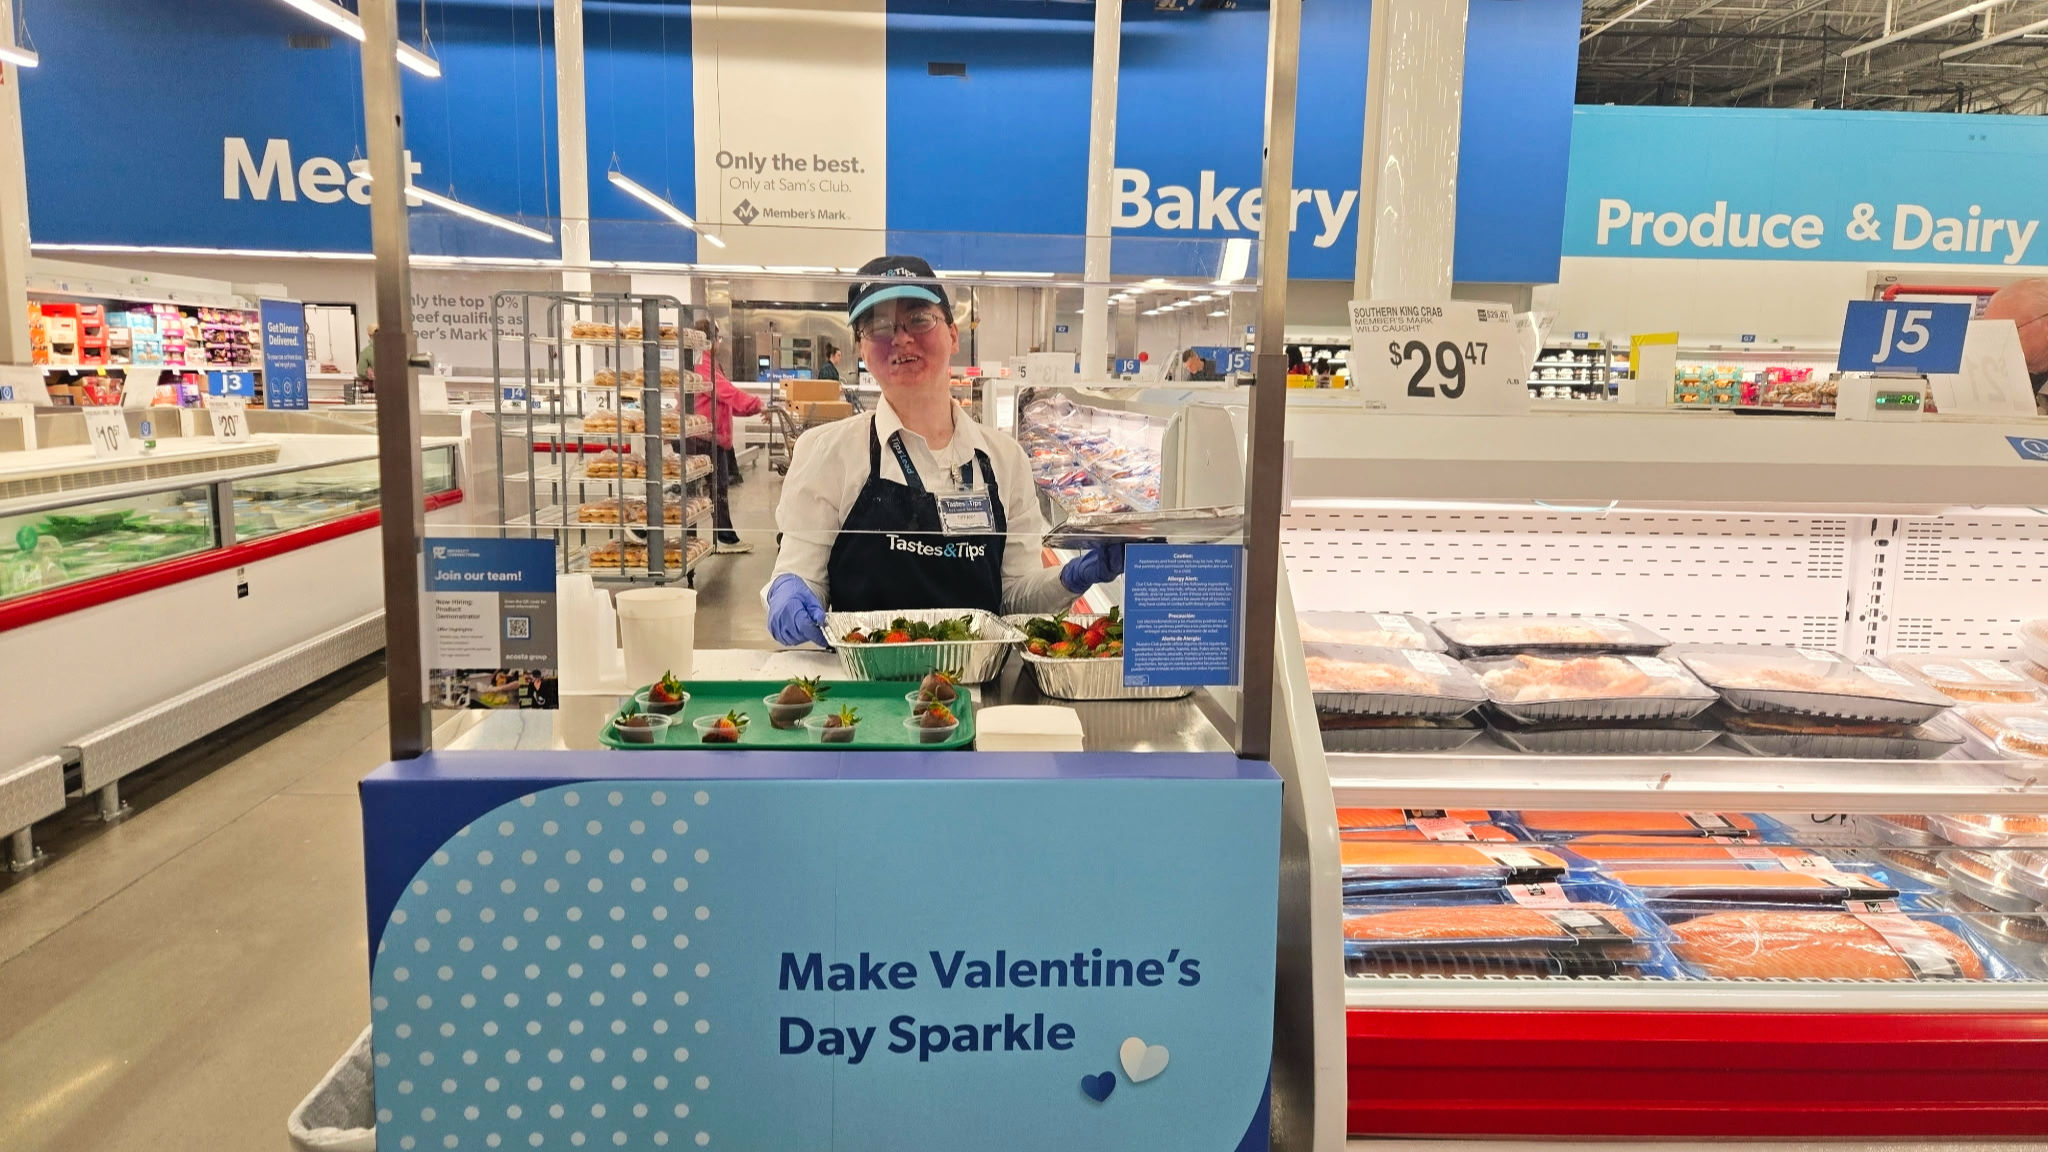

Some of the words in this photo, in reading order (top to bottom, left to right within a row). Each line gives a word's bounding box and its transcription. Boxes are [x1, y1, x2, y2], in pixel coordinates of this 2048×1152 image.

[715, 150, 767, 175] Only
[771, 153, 807, 172] the
[813, 154, 865, 174] best.
[223, 136, 423, 207] Meat
[729, 176, 760, 193] Only
[763, 179, 776, 191] at
[779, 178, 816, 192] Sam's
[819, 179, 852, 193] Club.
[762, 207, 815, 219] Member's
[817, 209, 846, 220] Mark
[1110, 167, 1359, 249] Bakery
[1596, 198, 1825, 249] Produce
[1845, 202, 1882, 242] &
[1892, 203, 2040, 265] Dairy
[432, 294, 457, 307] the
[460, 295, 485, 310] top
[1353, 306, 1398, 318] SOUTHERN
[1399, 305, 1420, 317] KING
[1420, 306, 1443, 318] CRAB
[267, 321, 280, 333] Get
[279, 323, 299, 334] Dinner
[507, 316, 524, 325] as
[1354, 317, 1405, 325] MEMBER'S
[1406, 316, 1433, 325] MARK
[1355, 325, 1380, 333] WILD
[1381, 324, 1421, 333] CAUGHT
[268, 335, 300, 346] Delivered.
[450, 328, 488, 341] Mark
[1871, 309, 1933, 364] J5
[1122, 359, 1135, 371] J6
[1225, 353, 1245, 372] J5
[221, 374, 241, 394] J3
[886, 534, 985, 561] Tastes&Tips
[434, 570, 462, 581] Join
[463, 572, 485, 581] our
[487, 570, 523, 581] team!
[778, 951, 918, 992] Make
[929, 947, 1201, 989] Valentine's
[778, 1015, 877, 1065] Day
[887, 1012, 1076, 1062] Sparkle
